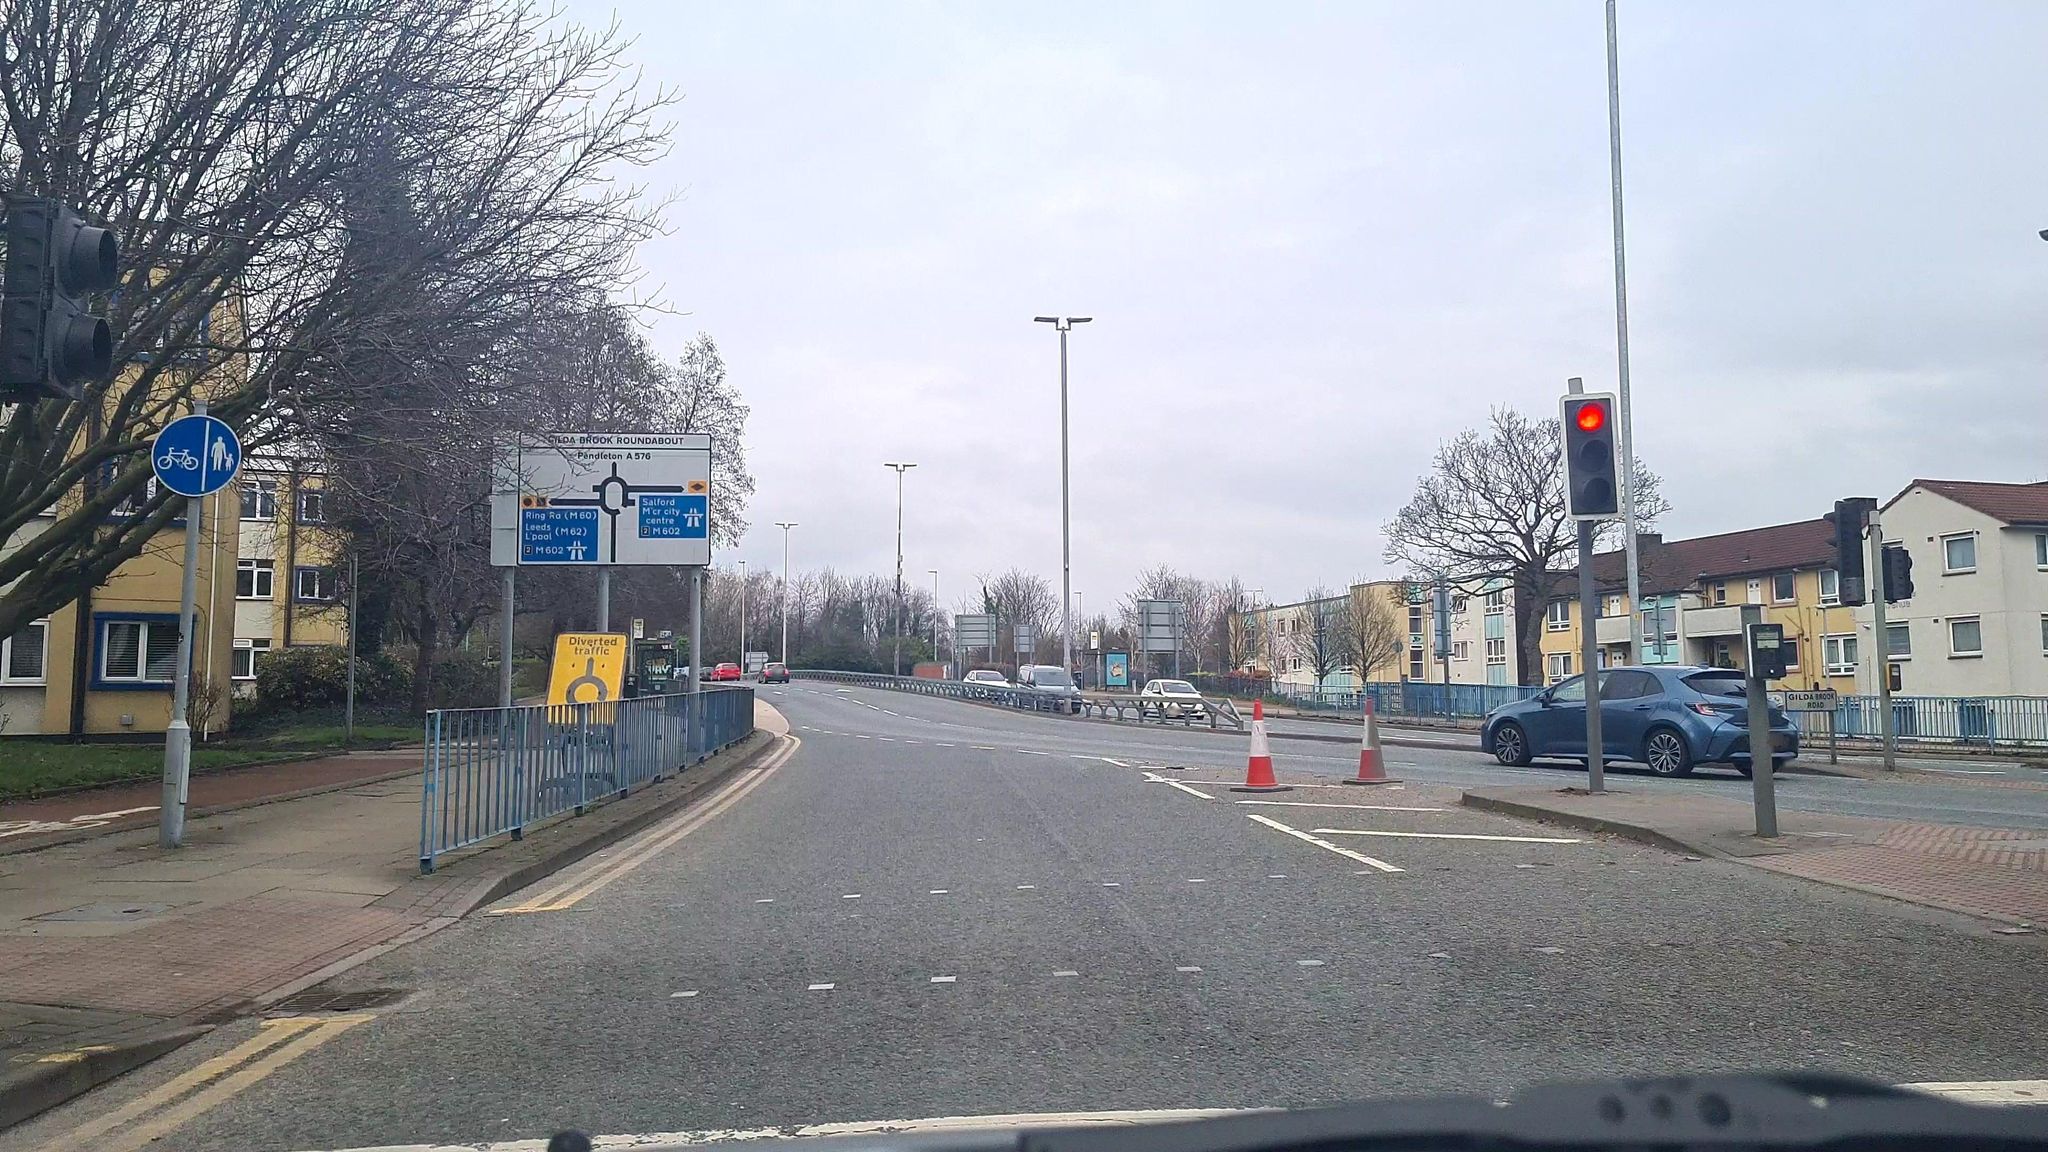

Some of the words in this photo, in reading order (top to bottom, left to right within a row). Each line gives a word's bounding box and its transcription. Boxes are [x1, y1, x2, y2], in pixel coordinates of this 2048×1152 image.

[579, 437, 613, 445] BROOK
[616, 437, 684, 445] ROUNDABOUT
[577, 452, 622, 460] Pendleton
[642, 498, 675, 506] Salford
[525, 511, 546, 520] Ring
[642, 507, 661, 515] M'cr
[663, 507, 680, 516] city
[645, 517, 674, 525] centre
[525, 523, 551, 531] Leeds
[525, 532, 552, 541] L'pool
[569, 636, 618, 646] Diverted
[574, 646, 610, 656] traffic
[1788, 693, 1814, 701] GILDA
[1815, 692, 1835, 701] BROOK
